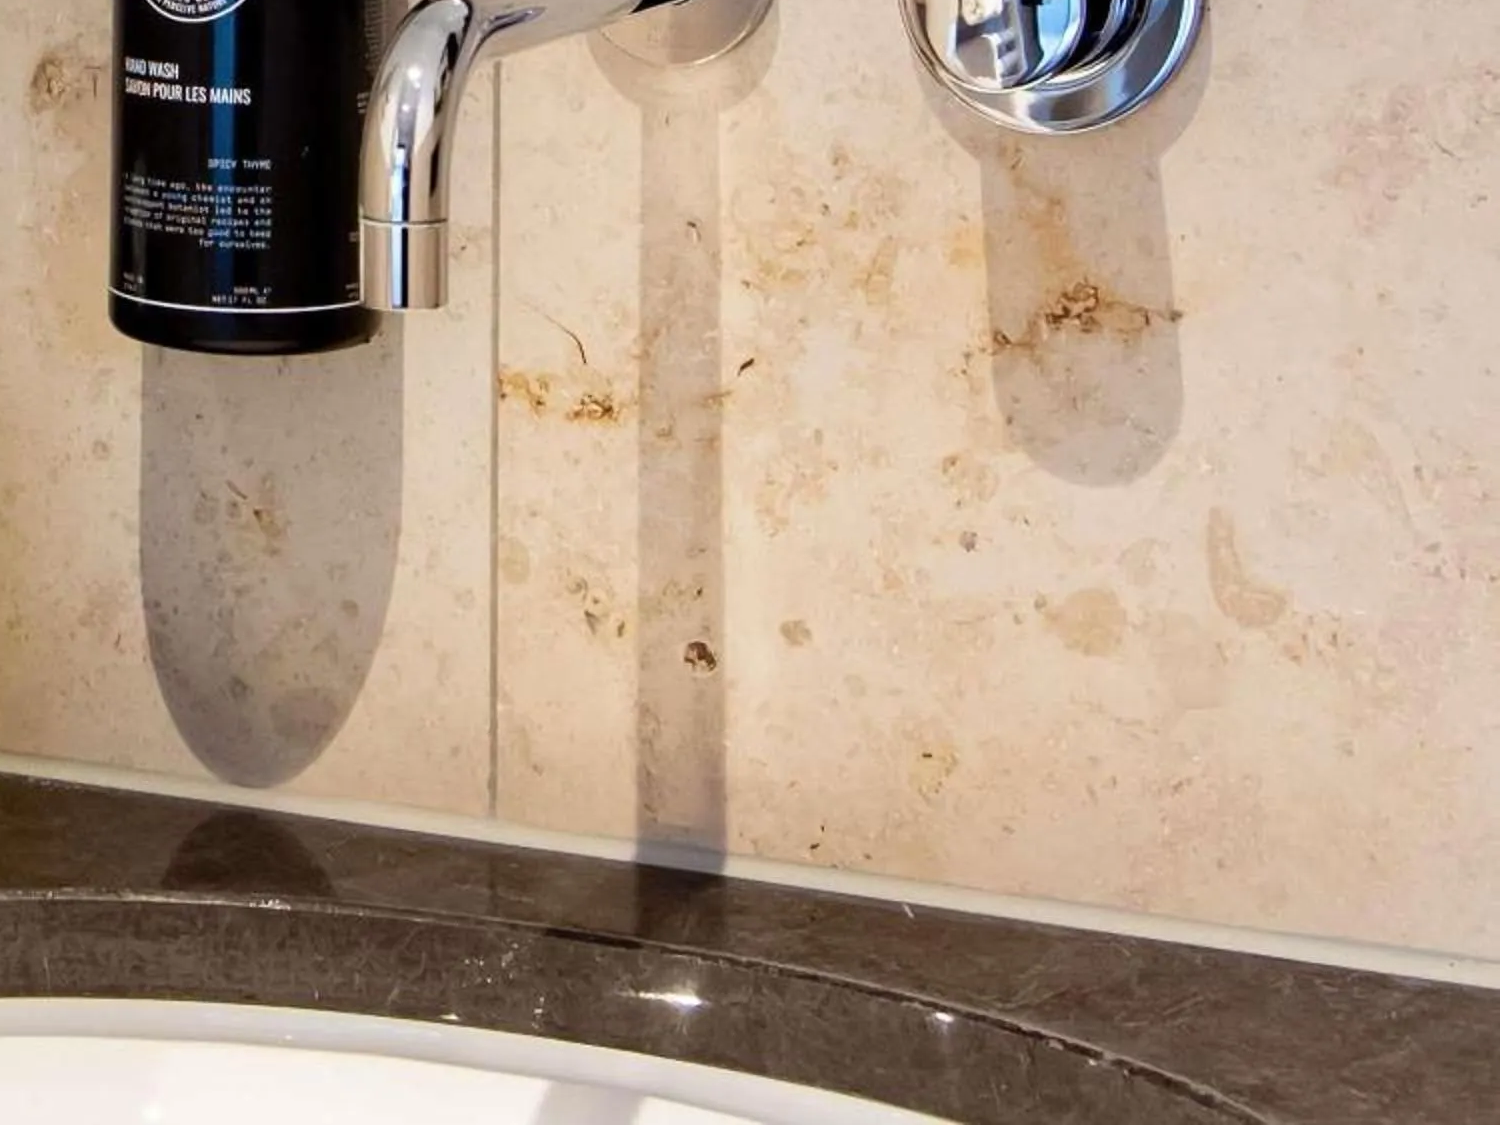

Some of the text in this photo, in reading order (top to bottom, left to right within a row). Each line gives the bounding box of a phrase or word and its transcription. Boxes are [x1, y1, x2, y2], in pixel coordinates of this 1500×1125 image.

[125, 56, 180, 80] HAND WASH
[125, 76, 252, 106] SAVON POUR LES MAINS
[243, 159, 272, 170] THYME
[195, 182, 213, 192] the
[217, 184, 273, 194] encounter
[190, 193, 232, 205] chemist
[237, 196, 255, 205] and
[214, 206, 233, 216] led
[253, 207, 272, 216] the
